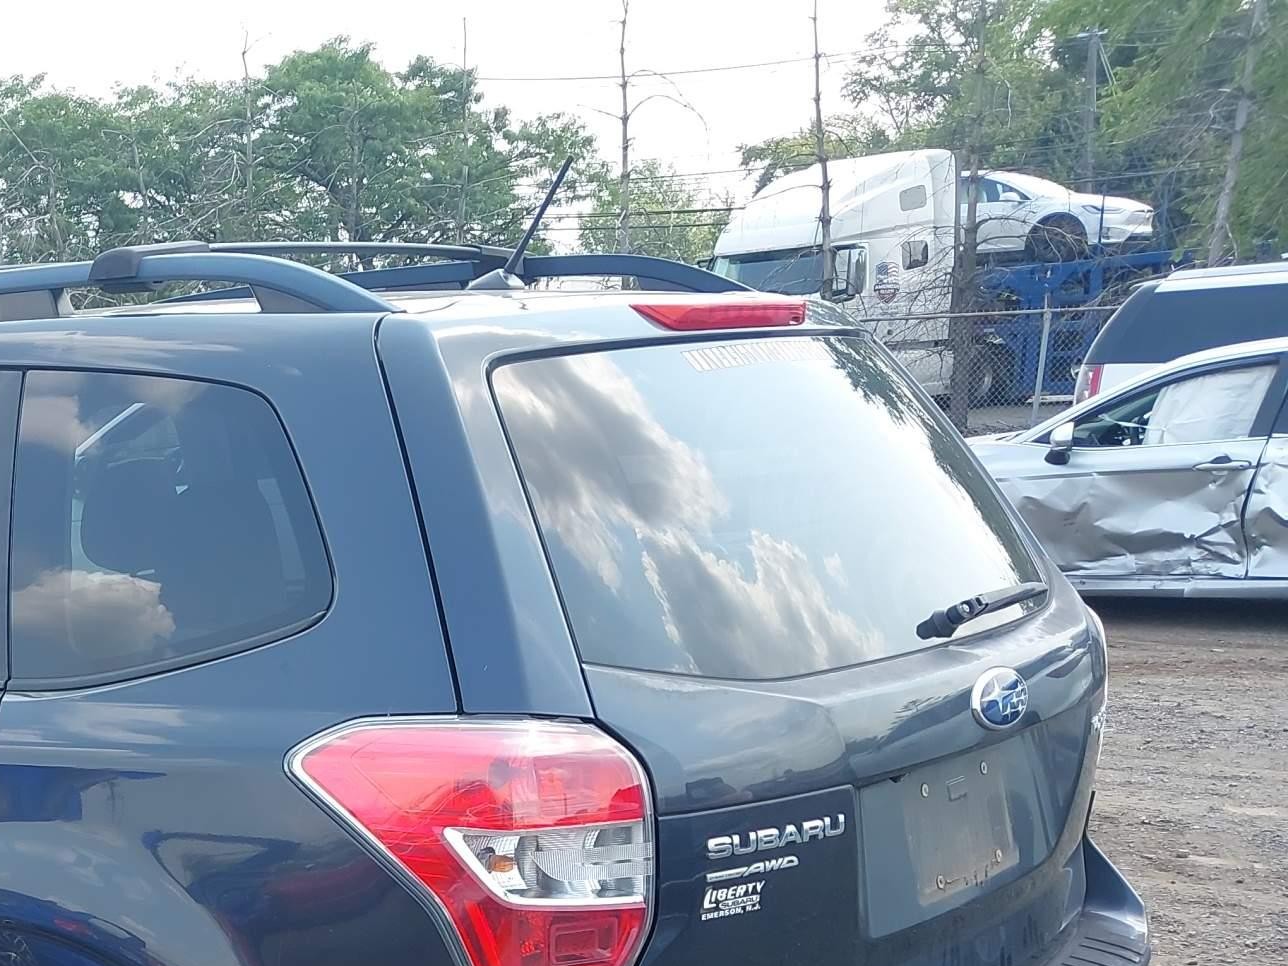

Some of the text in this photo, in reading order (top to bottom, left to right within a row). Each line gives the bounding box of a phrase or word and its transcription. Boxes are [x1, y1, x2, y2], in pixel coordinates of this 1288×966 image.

[707, 813, 845, 860] SUBARU
[743, 855, 799, 877] AWD
[703, 880, 766, 909] LIBERTY
[720, 894, 760, 910] SUBARU
[701, 903, 761, 921] EMERSON, N.J.
